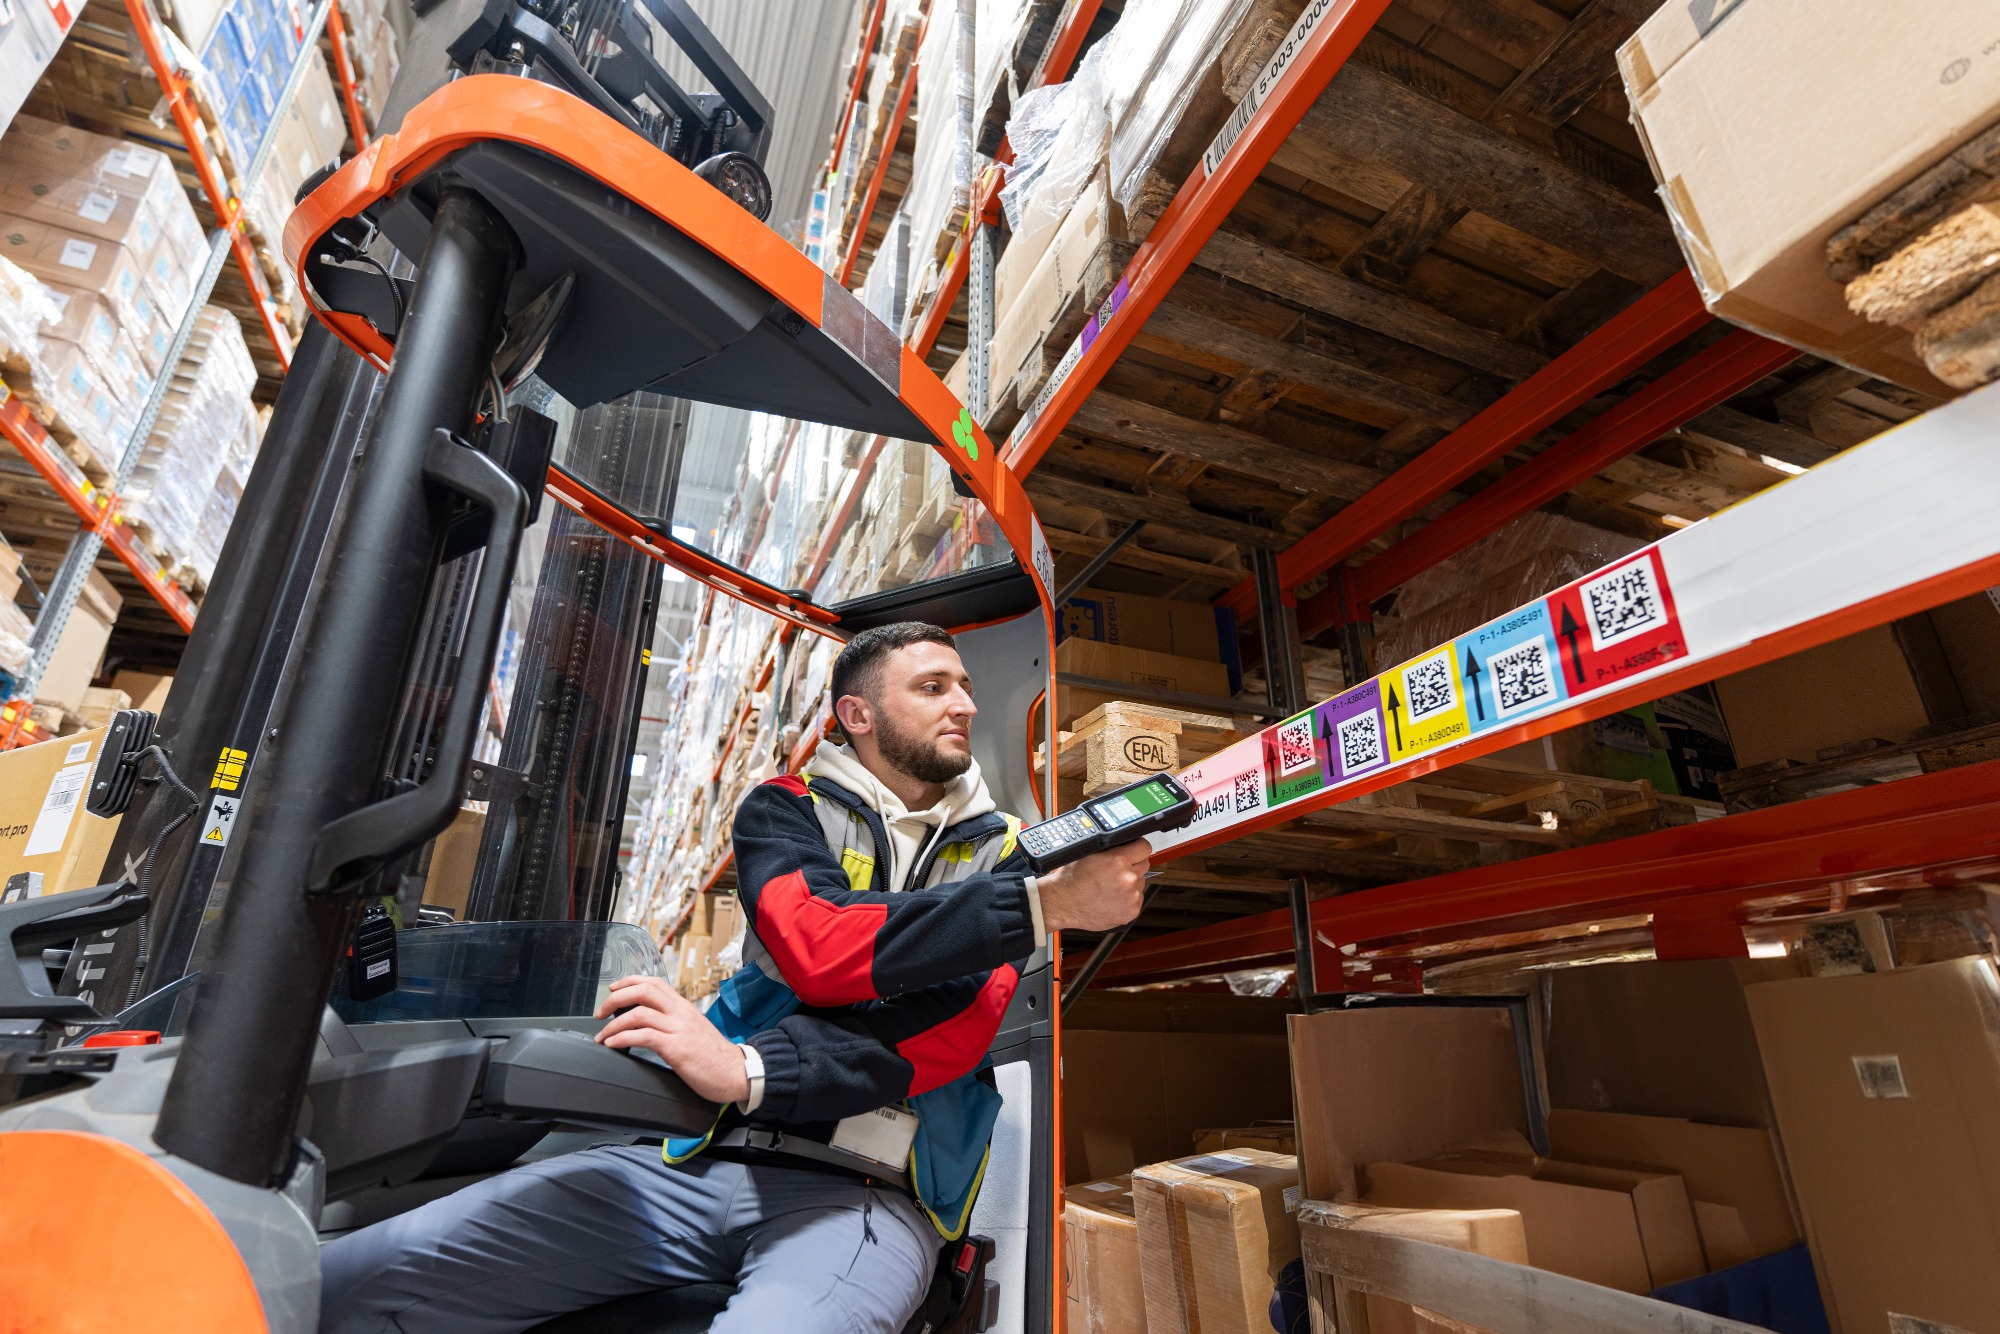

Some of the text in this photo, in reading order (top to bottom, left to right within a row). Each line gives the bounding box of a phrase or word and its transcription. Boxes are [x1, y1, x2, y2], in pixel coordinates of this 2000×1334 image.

[1106, 596, 1120, 645] toresu
[1479, 608, 1543, 645] P-1-A380E491
[1332, 687, 1378, 713] P-1-A380C491
[1410, 722, 1465, 750] P-1-A380D491
[1132, 742, 1169, 766] EPAL
[1183, 769, 1203, 785] P-1-A
[1281, 776, 1321, 798] P-1-A380B491
[9, 824, 28, 840] pro
